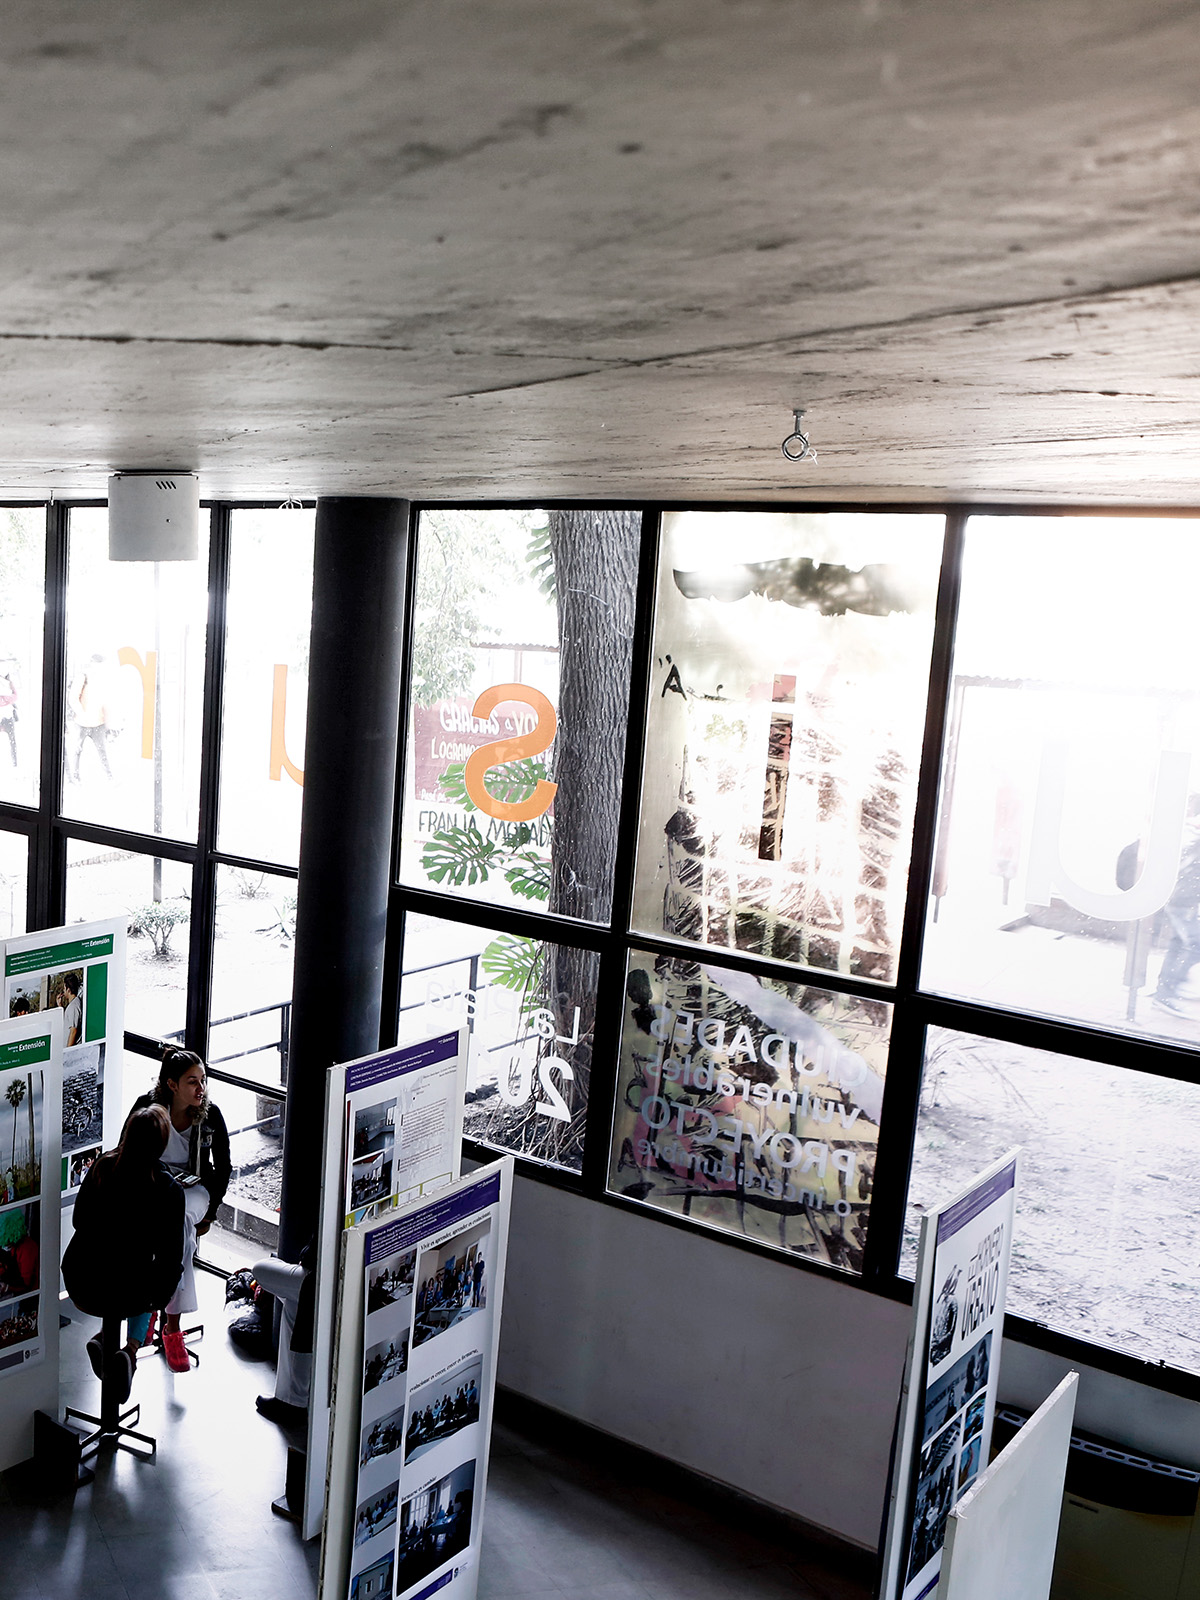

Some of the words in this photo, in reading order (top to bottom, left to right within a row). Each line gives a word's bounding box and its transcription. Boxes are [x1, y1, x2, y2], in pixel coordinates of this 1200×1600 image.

[513, 711, 539, 737] VO
[419, 811, 476, 833] FRANJA
[18, 1039, 46, 1052] Extensión
[961, 1260, 1000, 1341] URBANO
